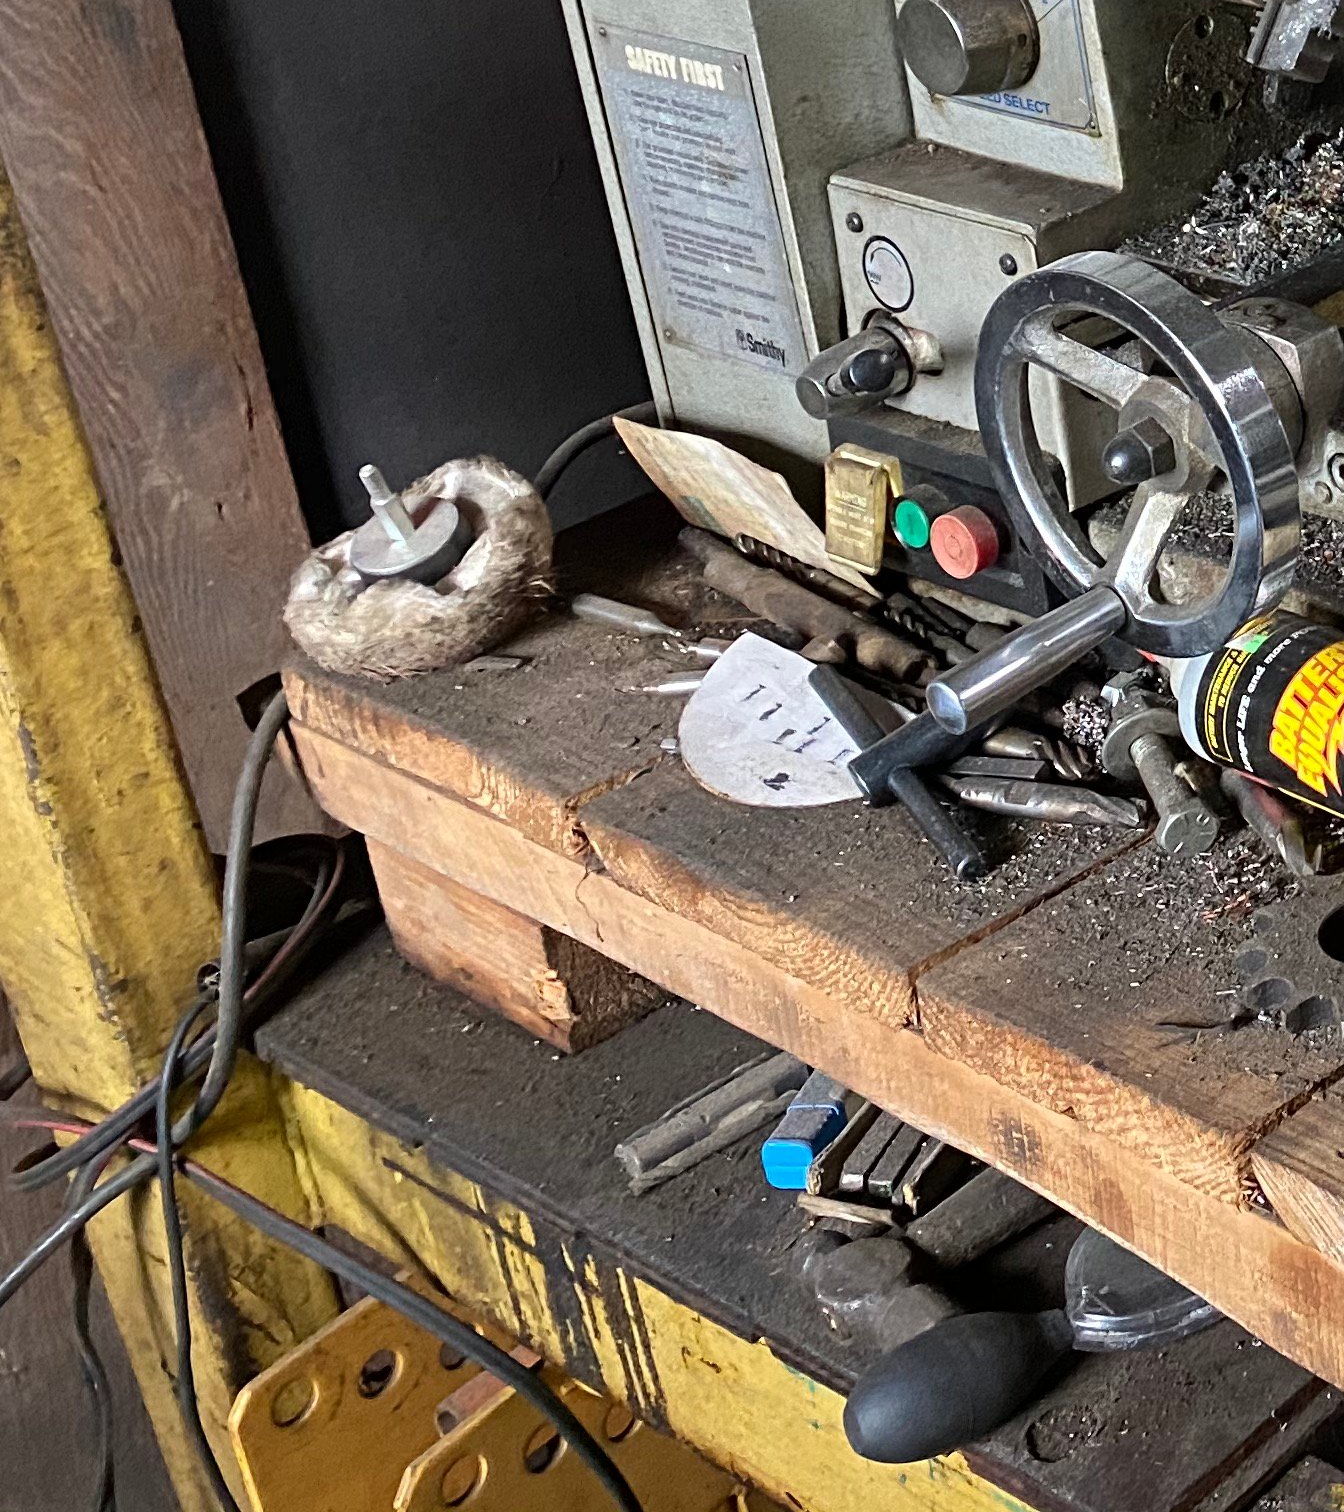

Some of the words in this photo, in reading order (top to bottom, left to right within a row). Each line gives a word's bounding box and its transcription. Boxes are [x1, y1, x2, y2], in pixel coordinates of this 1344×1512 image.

[625, 44, 677, 80] SAFETY
[680, 57, 725, 91] FIRST
[1003, 93, 1051, 115] SELECT
[746, 333, 785, 368] Smithy
[1247, 665, 1266, 693] and
[1264, 639, 1292, 664] more
